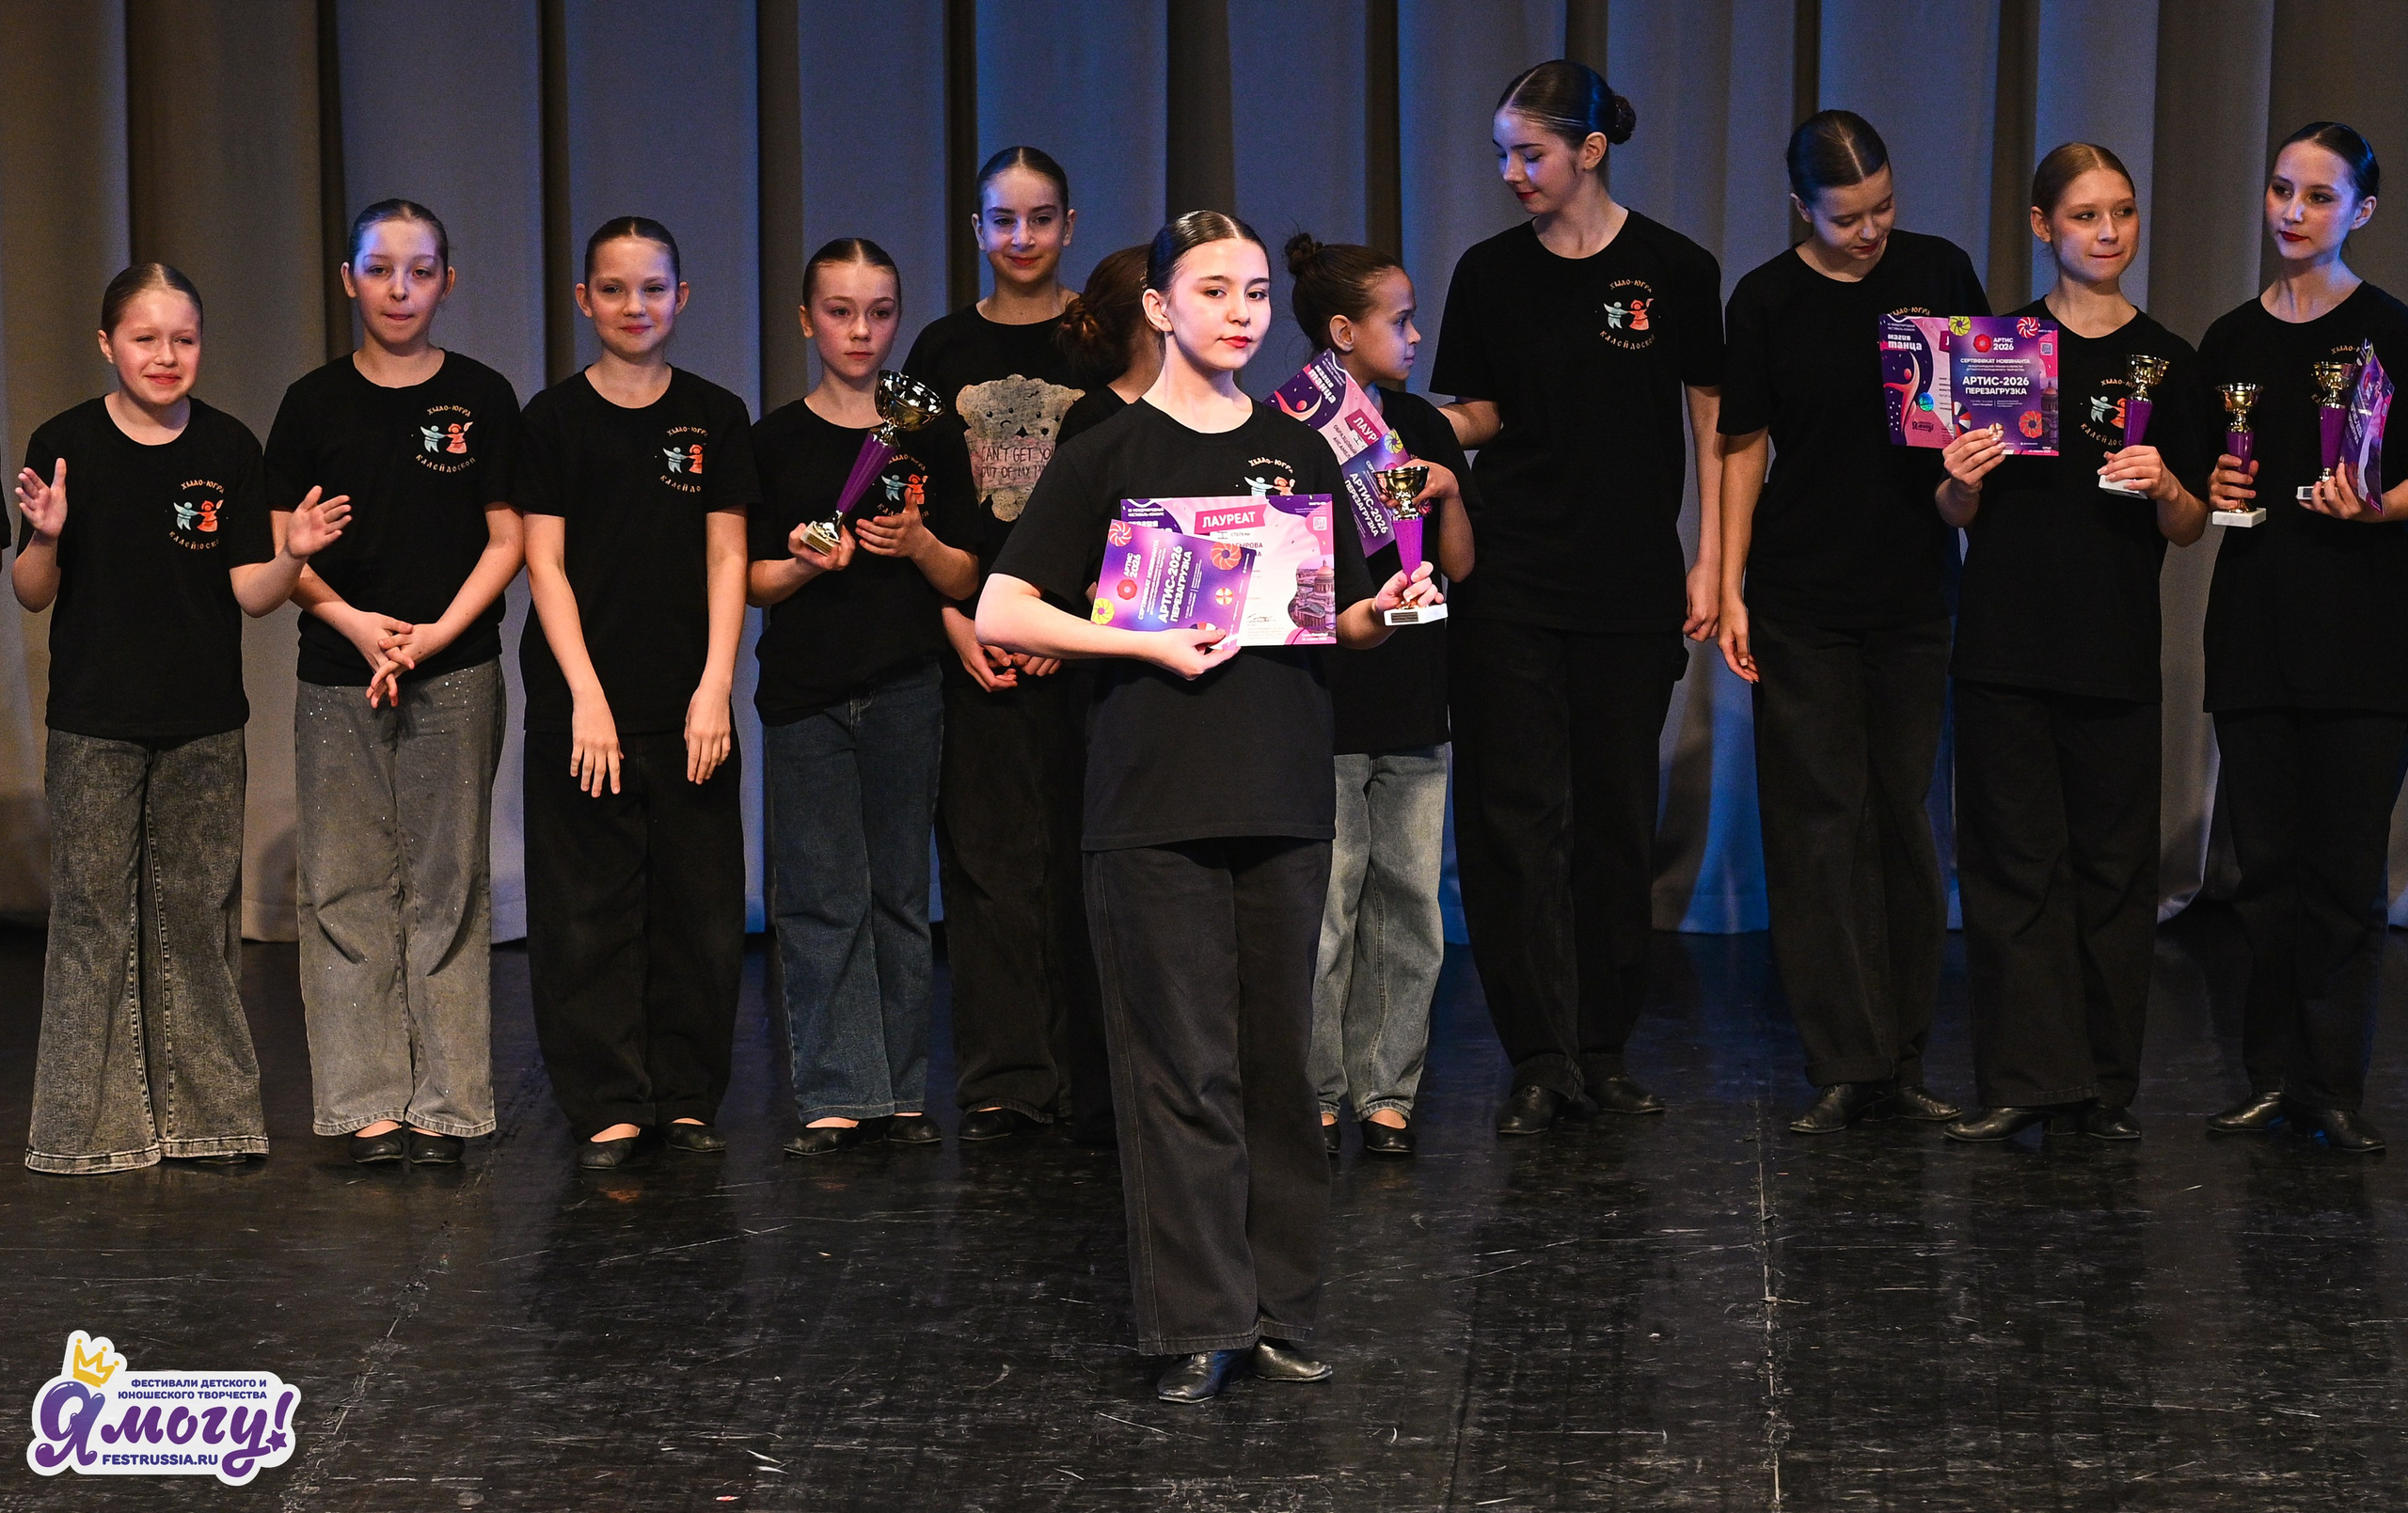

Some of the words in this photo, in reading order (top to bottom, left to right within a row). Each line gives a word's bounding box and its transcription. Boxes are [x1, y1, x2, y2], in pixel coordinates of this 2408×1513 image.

[1962, 376, 2030, 386] АРТИС-2026
[2080, 422, 2123, 447] КАЛЕЙДОС
[1013, 447, 1035, 462] GET
[1332, 436, 1352, 459] АНСАМБЛ
[981, 465, 998, 478] OUT
[1000, 466, 1016, 478] OF
[1344, 480, 1379, 537] ПЕРЕЗАГРУЗКА
[1349, 473, 1389, 534] АРТИС-2026
[1202, 511, 1256, 528] ЛАУРЕАТ
[1123, 552, 1133, 577] АРТИС
[1130, 554, 1142, 578] 2026
[1158, 545, 1183, 623] АРТИС-2026
[1170, 551, 1193, 622] ПЕРЕЗАГРУЗКА
